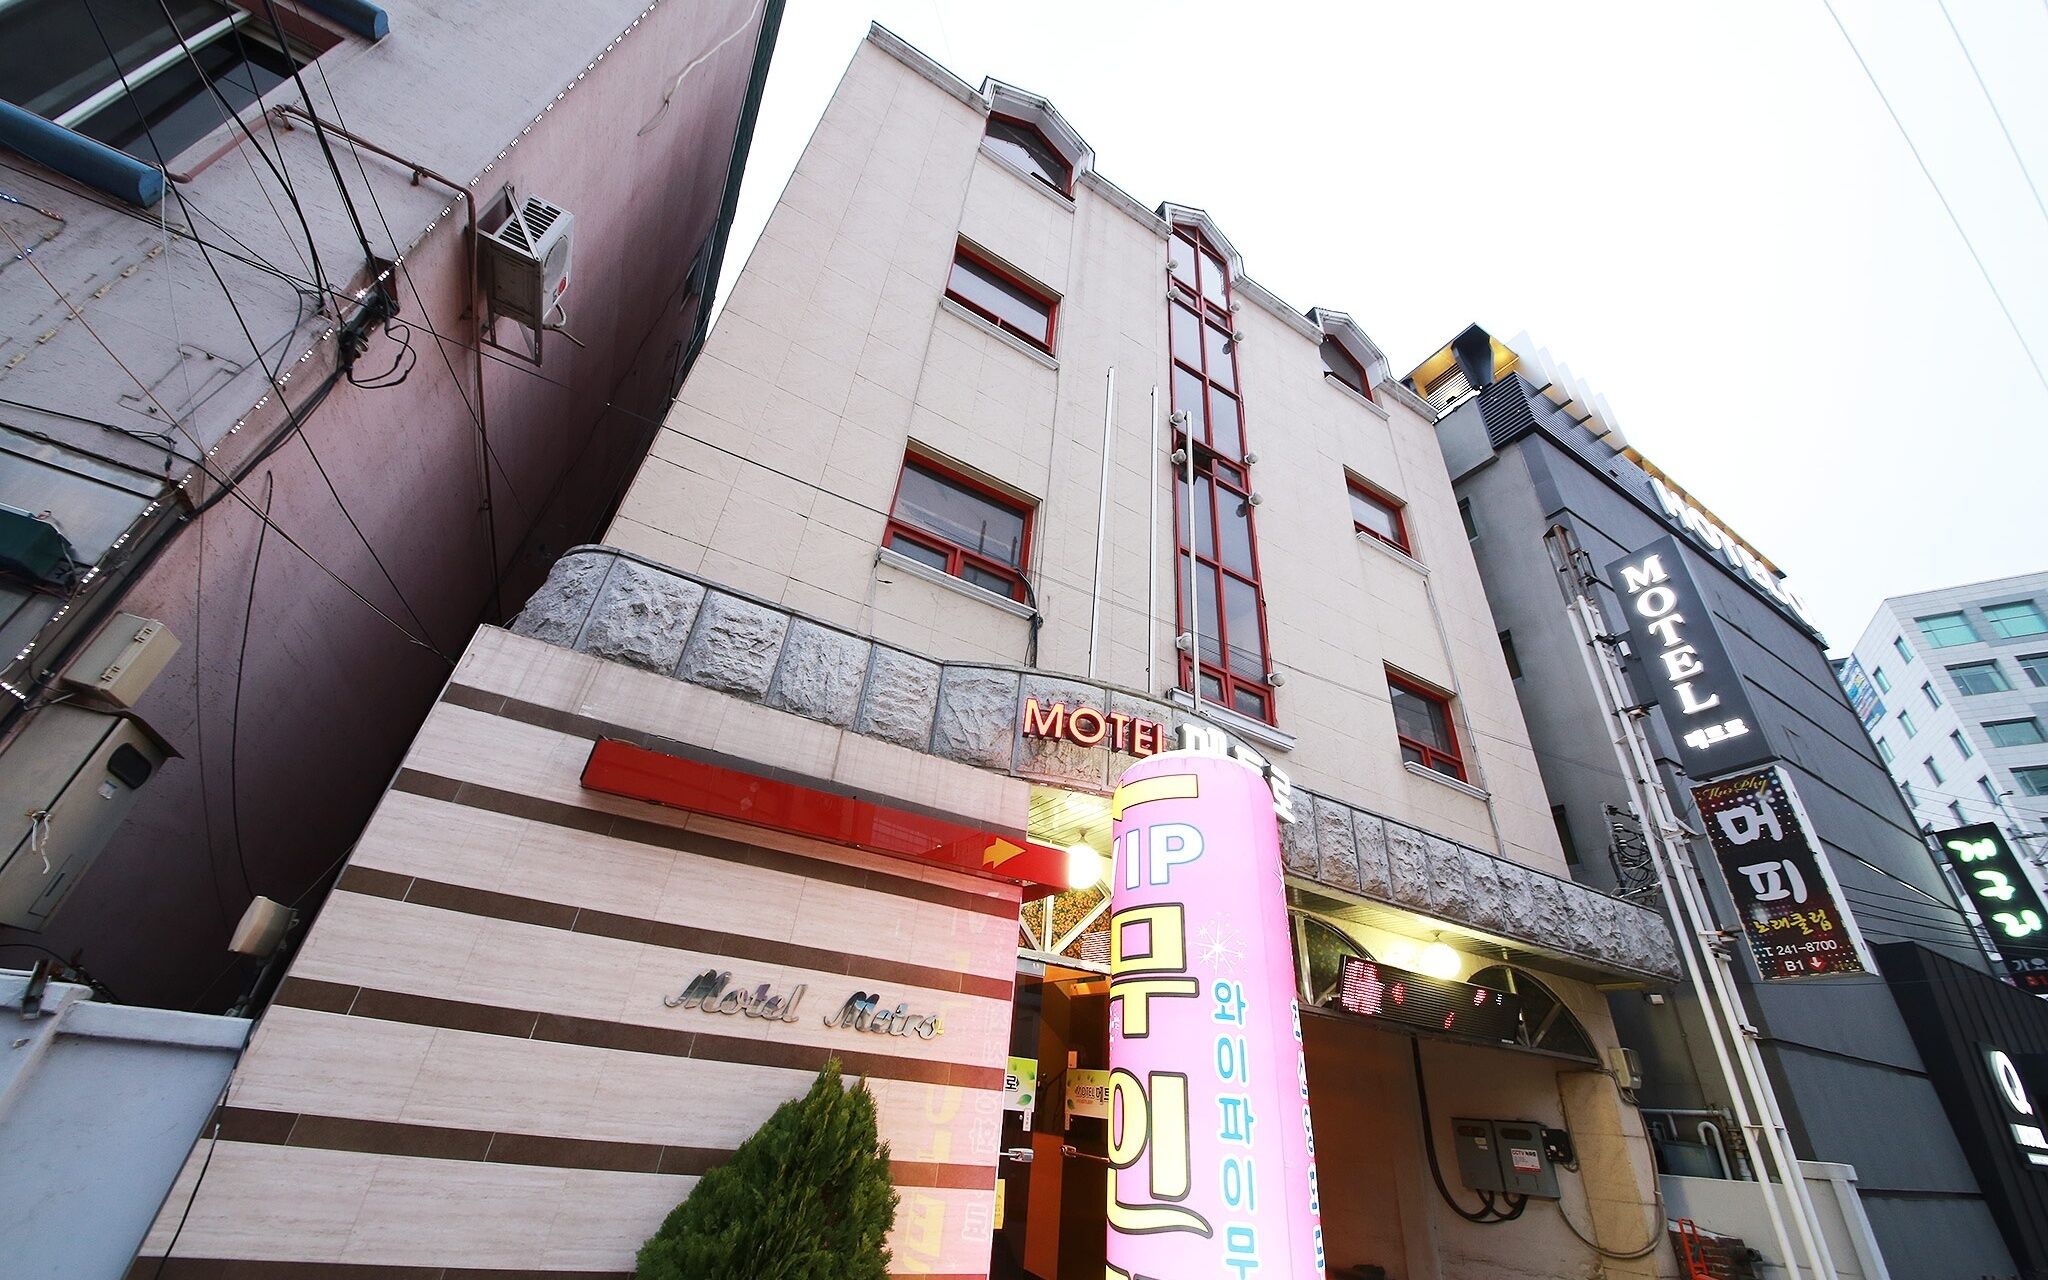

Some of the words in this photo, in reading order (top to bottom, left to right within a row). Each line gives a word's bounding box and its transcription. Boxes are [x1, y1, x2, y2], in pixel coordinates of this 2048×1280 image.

[1621, 553, 1720, 715] MOTEL
[1022, 697, 1167, 760] MOTEL
[1716, 799, 1808, 904] 머피
[1753, 908, 1833, 935] 노래클럽
[1776, 939, 1838, 956] 241-8700
[1784, 960, 1804, 972] B1
[664, 968, 808, 1023] Motel
[823, 991, 944, 1040] Metro
[1107, 901, 1214, 1280] 무인
